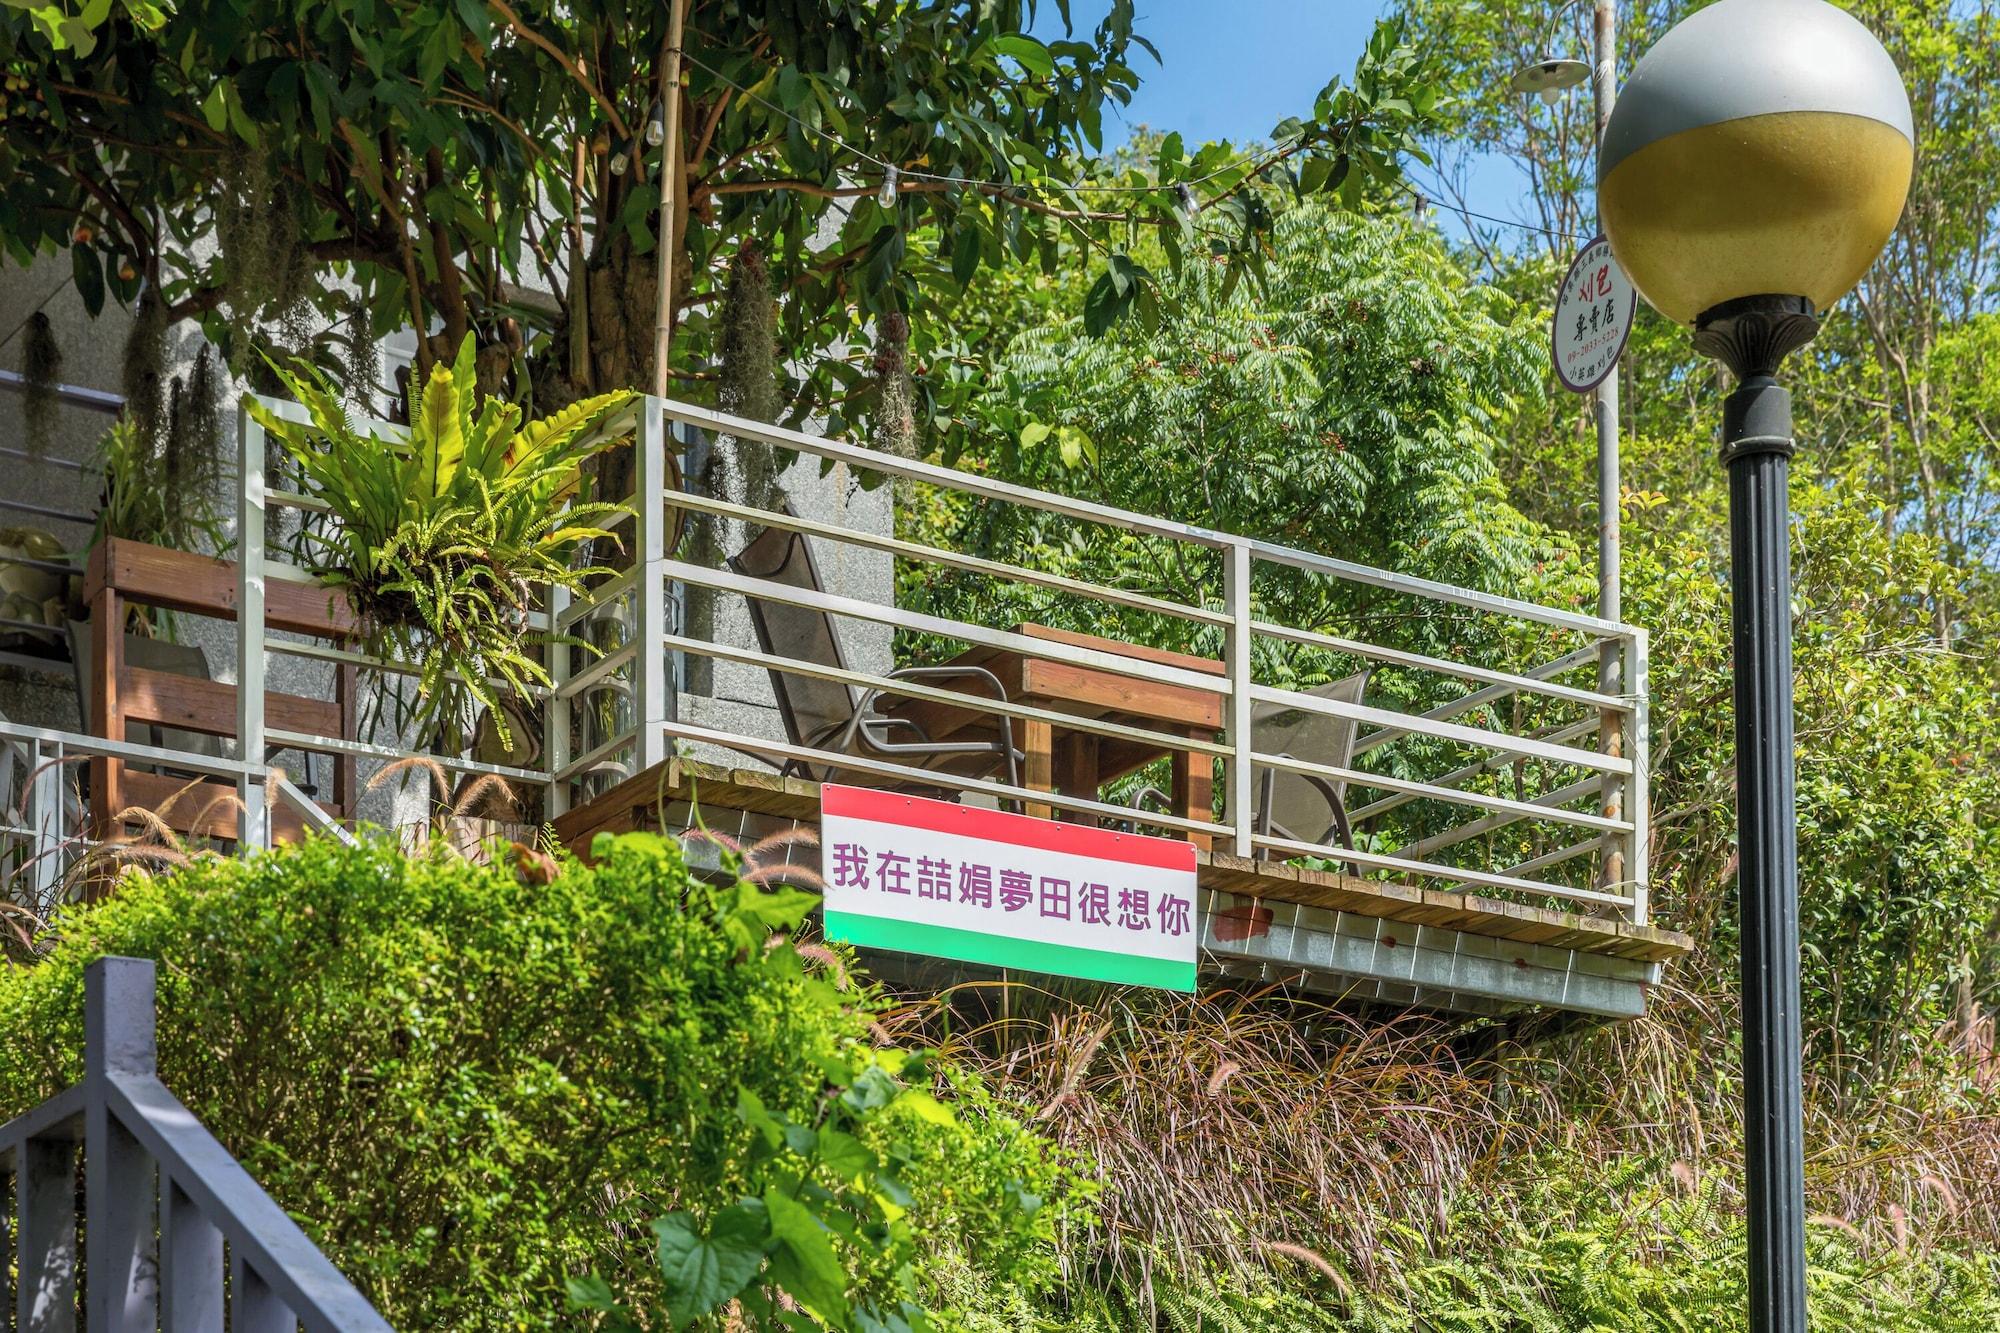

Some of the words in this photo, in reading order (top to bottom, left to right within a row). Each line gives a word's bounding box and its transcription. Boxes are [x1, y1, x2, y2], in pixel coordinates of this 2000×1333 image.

[1578, 263, 1613, 303] 刈包
[1573, 298, 1615, 341] 專賣店
[832, 843, 1191, 936] 我在喆娟夢田很想你
